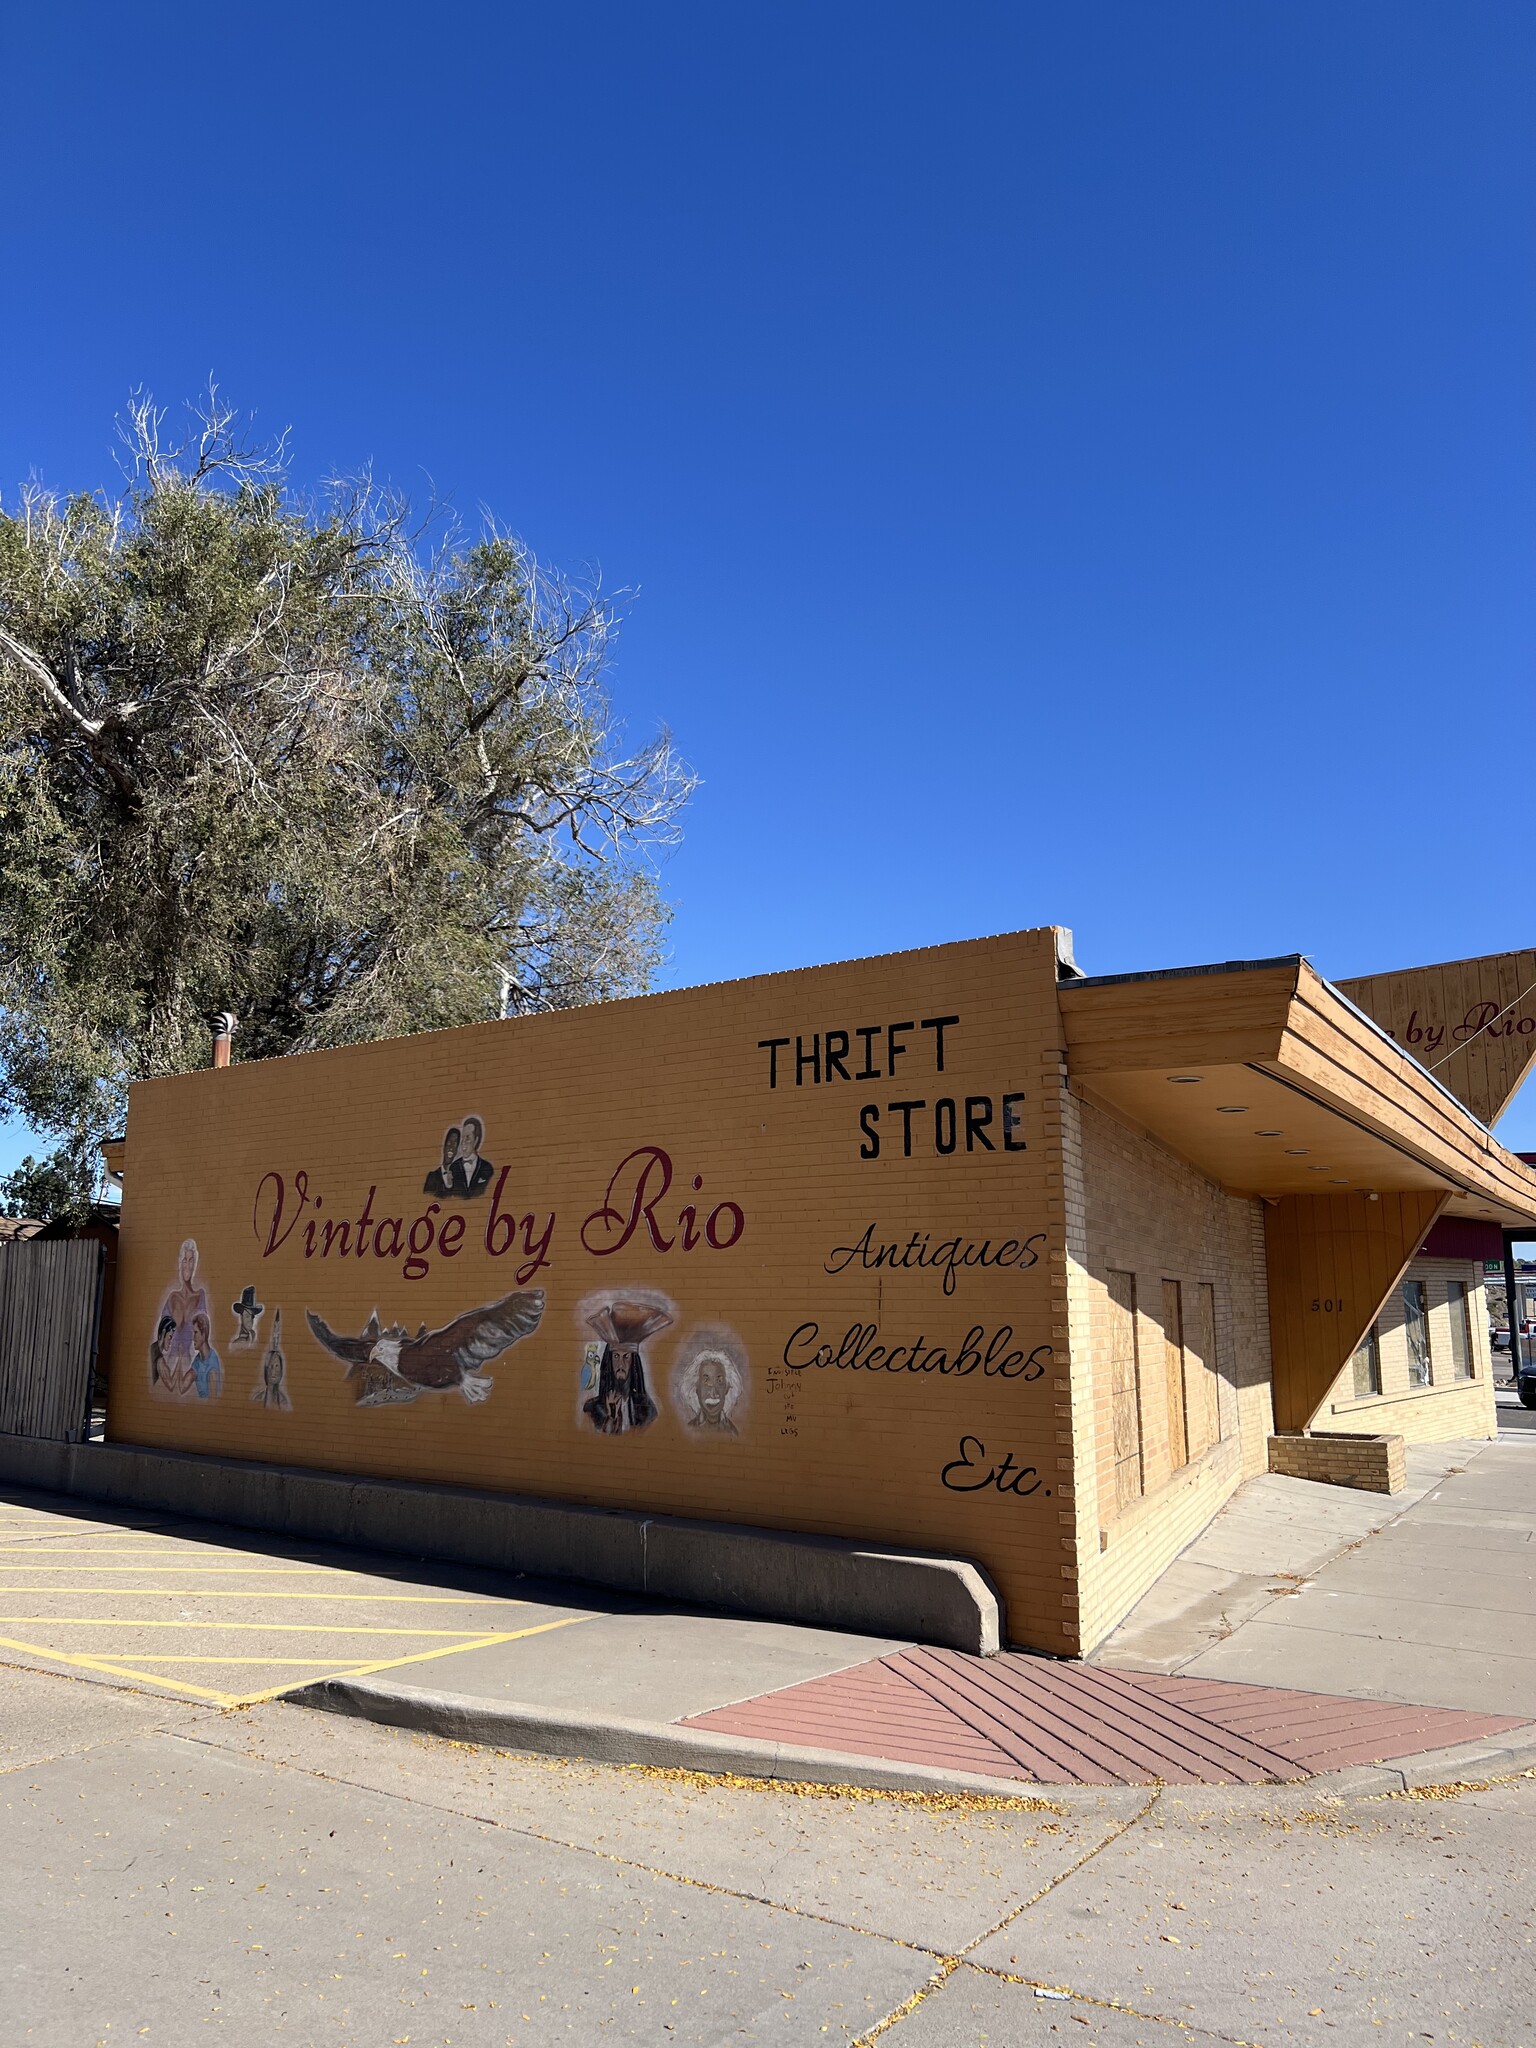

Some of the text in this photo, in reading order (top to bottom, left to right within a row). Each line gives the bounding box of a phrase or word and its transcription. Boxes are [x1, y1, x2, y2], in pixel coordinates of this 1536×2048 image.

[757, 1015, 960, 1089] THRIFT
[1406, 1001, 1536, 1052] by Rio
[860, 1092, 1026, 1159] STORE
[253, 1145, 746, 1285] Vintage by Rio
[824, 1223, 1048, 1295] Antiques
[1312, 1298, 1343, 1313] 501
[783, 1322, 1054, 1382] Collectables
[941, 1435, 1053, 1497] Etc.
